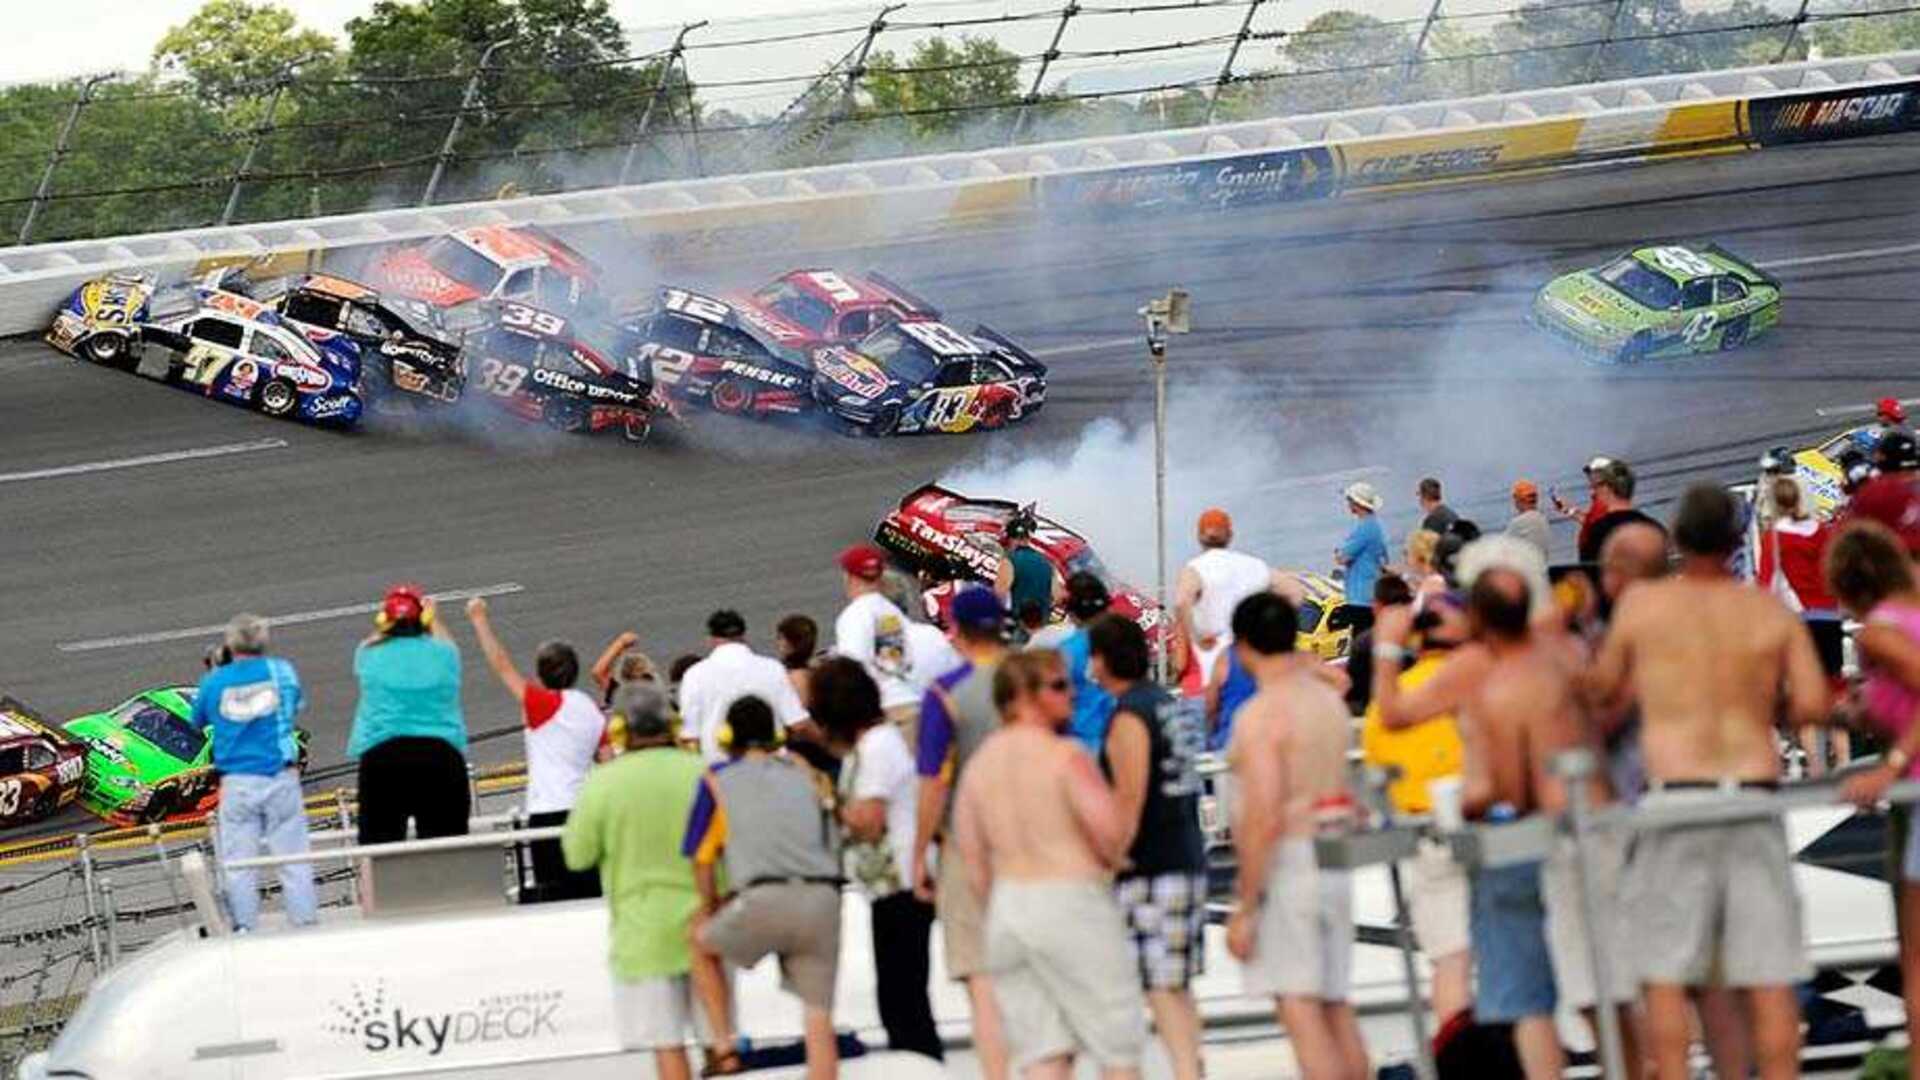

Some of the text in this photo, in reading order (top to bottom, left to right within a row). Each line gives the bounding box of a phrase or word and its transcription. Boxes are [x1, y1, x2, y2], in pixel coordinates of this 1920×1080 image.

[1811, 93, 1905, 126] NASCAR
[808, 271, 860, 301] 9
[501, 302, 566, 336] 39
[664, 288, 731, 323] 12
[1682, 310, 1719, 343] 43
[474, 357, 528, 397] 39
[638, 342, 694, 384] 12
[721, 360, 797, 388] PENSKE
[533, 368, 586, 393] Office
[928, 393, 968, 425] 83
[910, 516, 1000, 573] TaxSlaye
